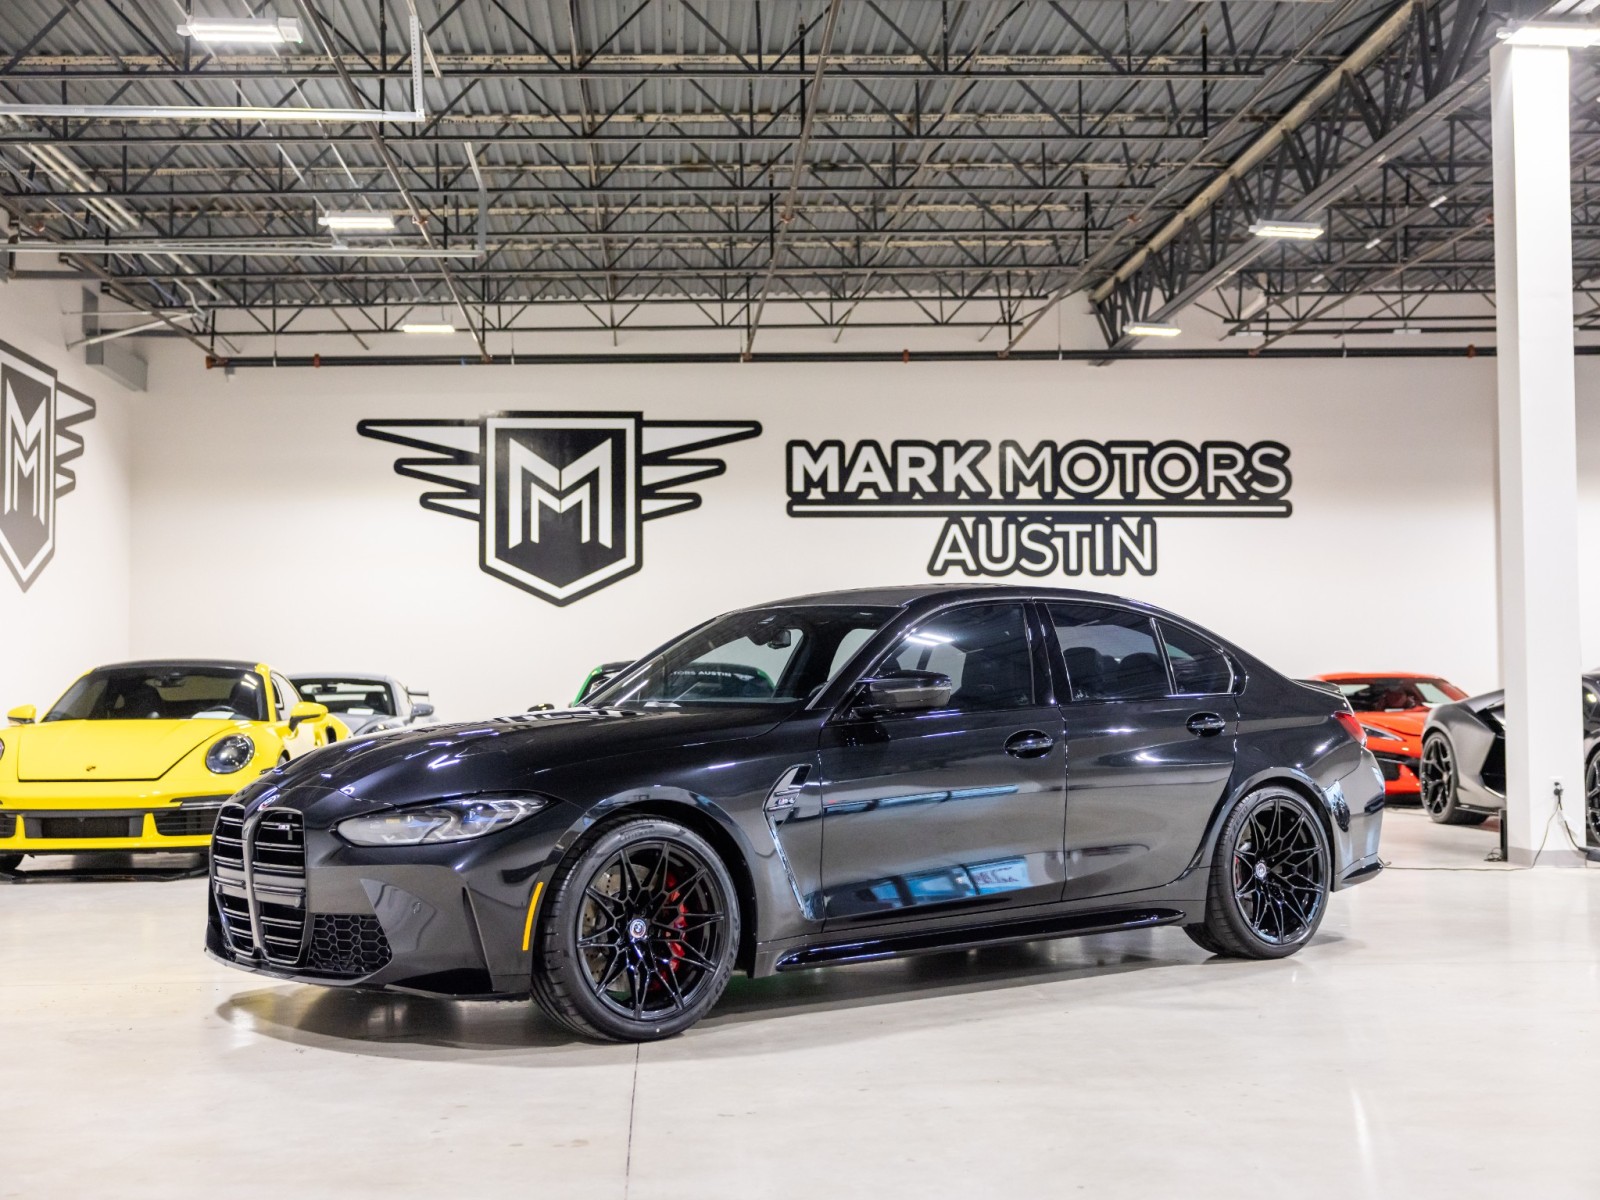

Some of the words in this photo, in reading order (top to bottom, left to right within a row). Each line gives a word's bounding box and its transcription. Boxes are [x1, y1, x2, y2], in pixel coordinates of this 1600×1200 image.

[790, 443, 988, 495] MARK
[1003, 443, 1289, 495] MOTORS
[931, 521, 1153, 573] AUSTIN
